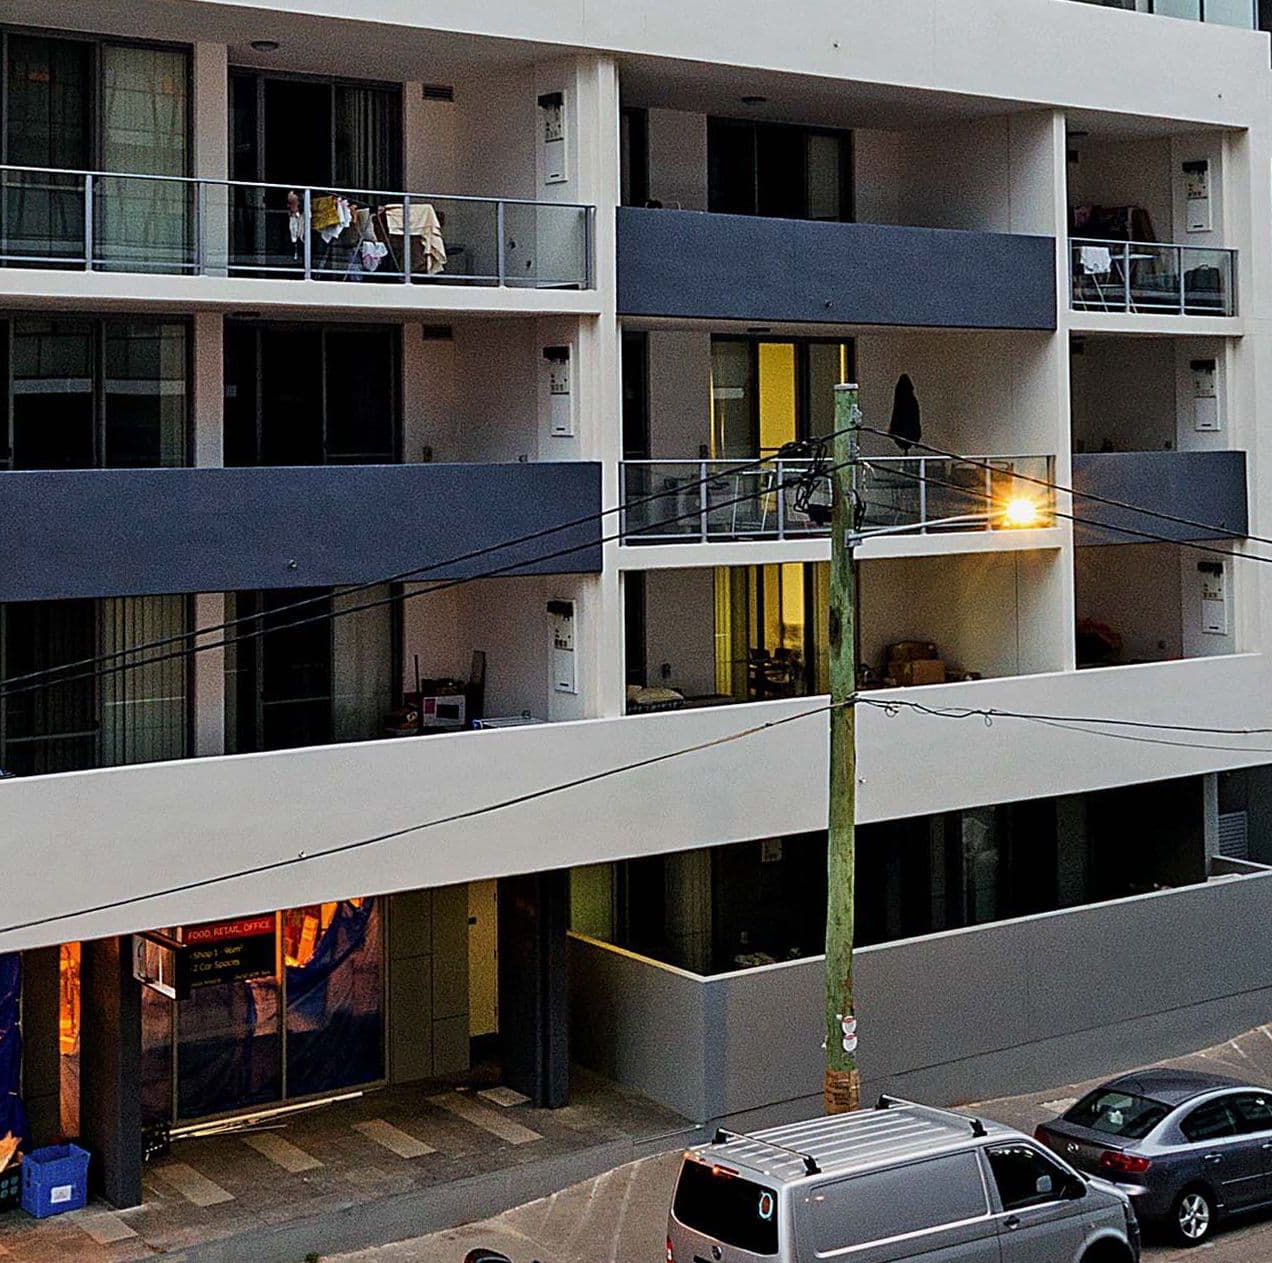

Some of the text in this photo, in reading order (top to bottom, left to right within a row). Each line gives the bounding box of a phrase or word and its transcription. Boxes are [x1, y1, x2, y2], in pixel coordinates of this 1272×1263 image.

[243, 920, 271, 932] OFFICE
[199, 962, 212, 971] Car
[214, 959, 240, 968] Spaces
